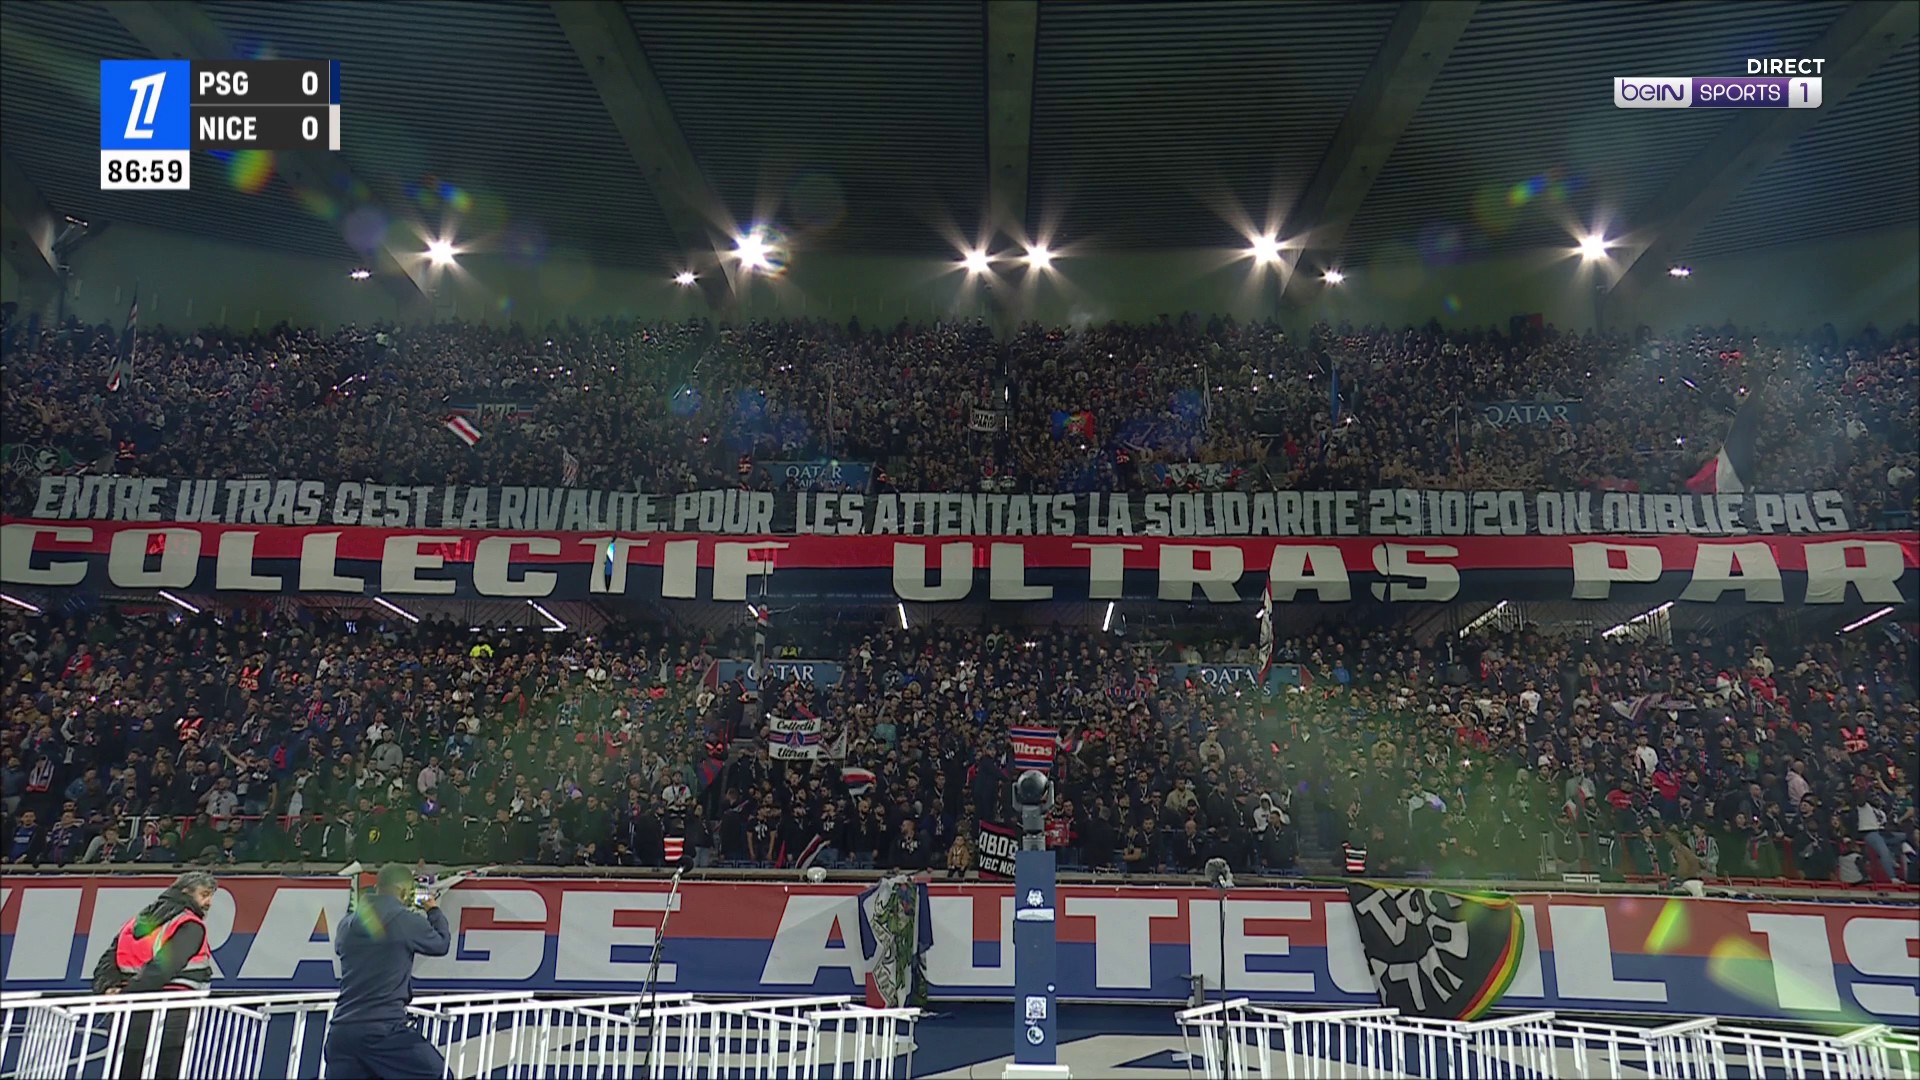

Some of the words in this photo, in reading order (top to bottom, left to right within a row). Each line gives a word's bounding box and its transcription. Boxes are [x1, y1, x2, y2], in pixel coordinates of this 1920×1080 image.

[1484, 405, 1568, 429] QATAR
[32, 476, 167, 521] ENTRE
[175, 479, 324, 525] ULTRAS
[442, 485, 488, 528] LA
[674, 488, 774, 533] POUR
[796, 491, 864, 534] LES
[872, 492, 1076, 535] ATTENTATS
[1088, 492, 1131, 535] LA
[1145, 491, 1358, 535] SOLIDARITE
[1537, 491, 1591, 535] ON
[1603, 492, 1748, 535] OUBLIE
[1755, 489, 1849, 532] PAS
[0, 523, 790, 600] COLLECTIF
[893, 541, 1459, 602] ULTRAS
[1202, 668, 1256, 687] QATA
[1013, 742, 1053, 756] Ultras
[0, 886, 681, 983] IRAGE
